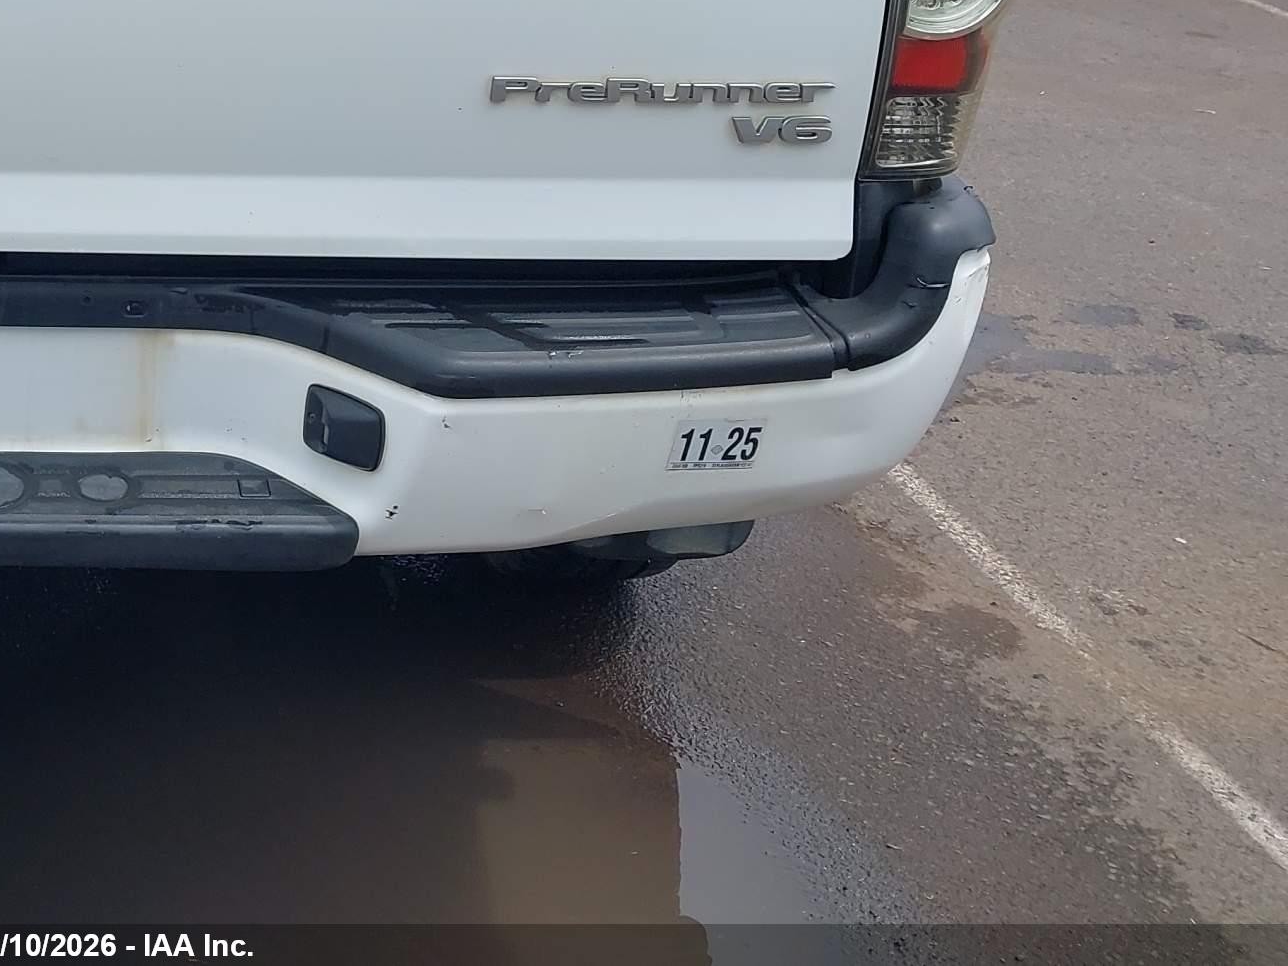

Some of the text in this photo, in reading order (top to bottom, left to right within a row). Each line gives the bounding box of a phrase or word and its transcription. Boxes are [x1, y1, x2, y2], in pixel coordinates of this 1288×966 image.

[489, 75, 836, 104] PreRunner
[730, 115, 833, 144] V6
[680, 426, 763, 462] 11 25
